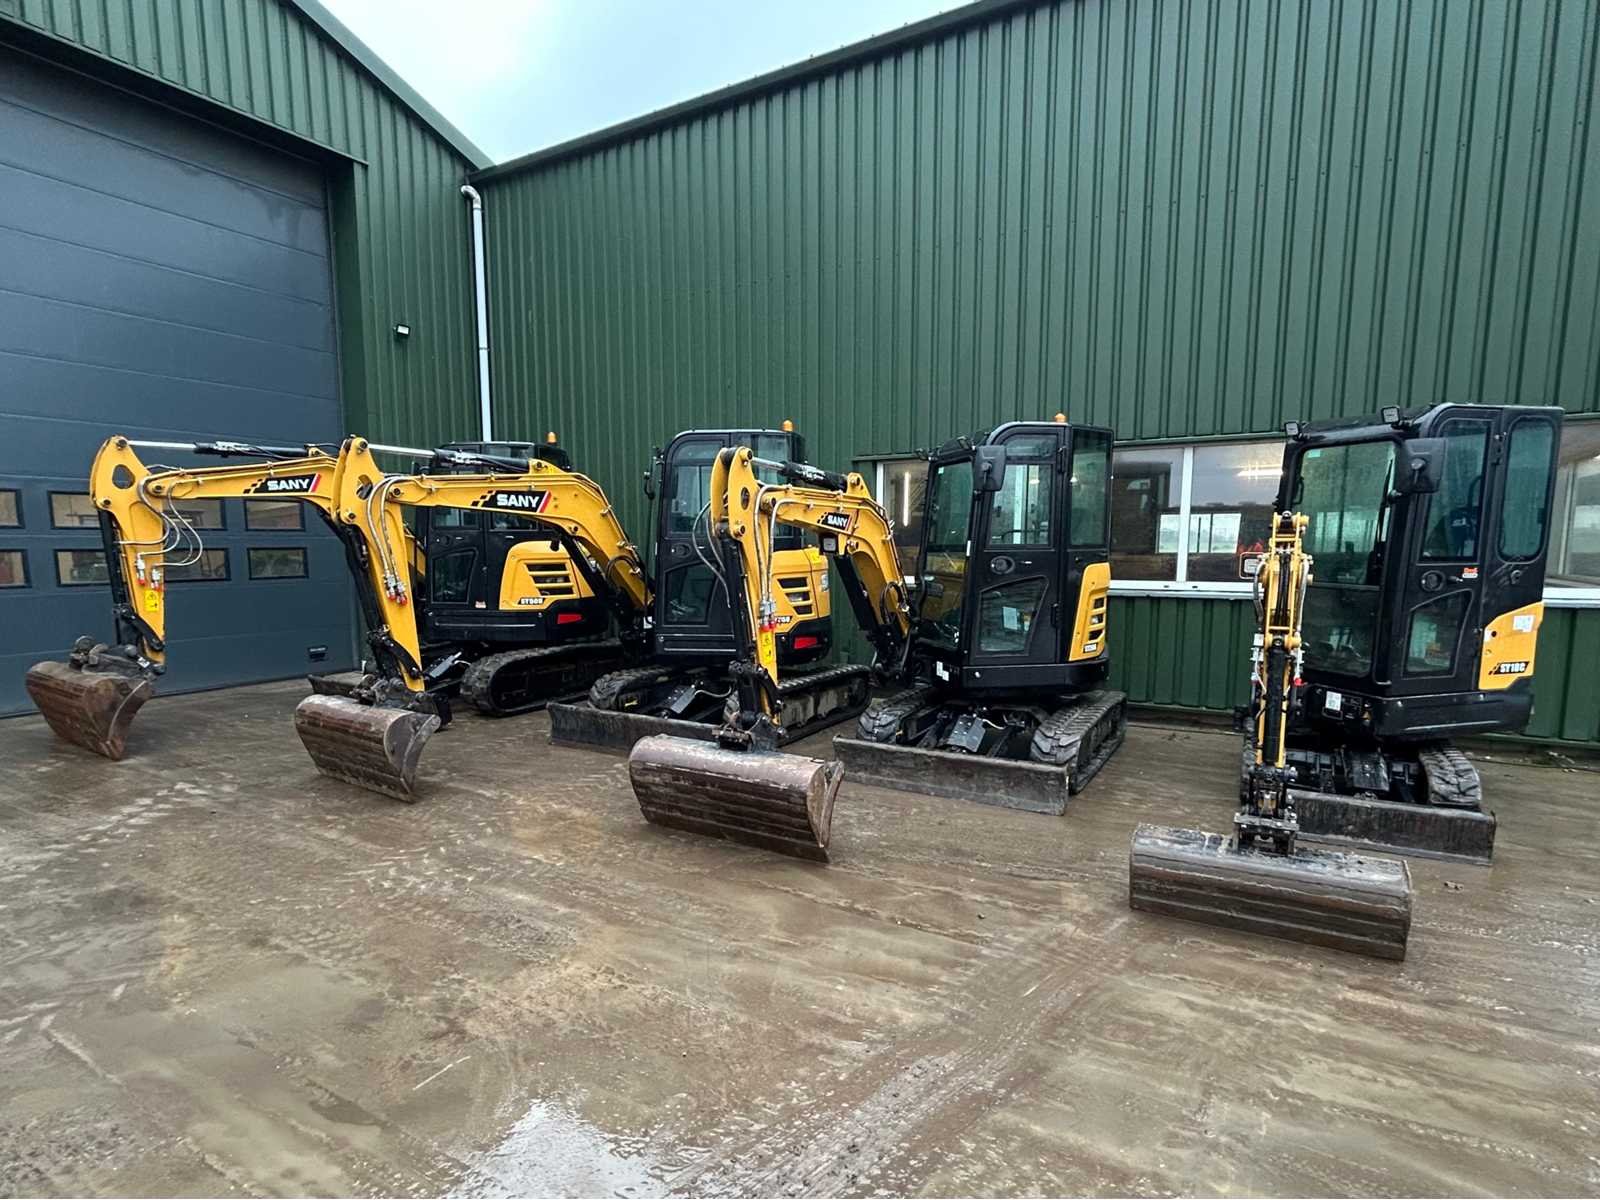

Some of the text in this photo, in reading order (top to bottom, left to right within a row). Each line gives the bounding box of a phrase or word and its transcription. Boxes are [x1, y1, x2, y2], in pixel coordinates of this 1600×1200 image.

[267, 478, 310, 491] SANY
[496, 493, 540, 508] SANY
[827, 514, 848, 527] SANY
